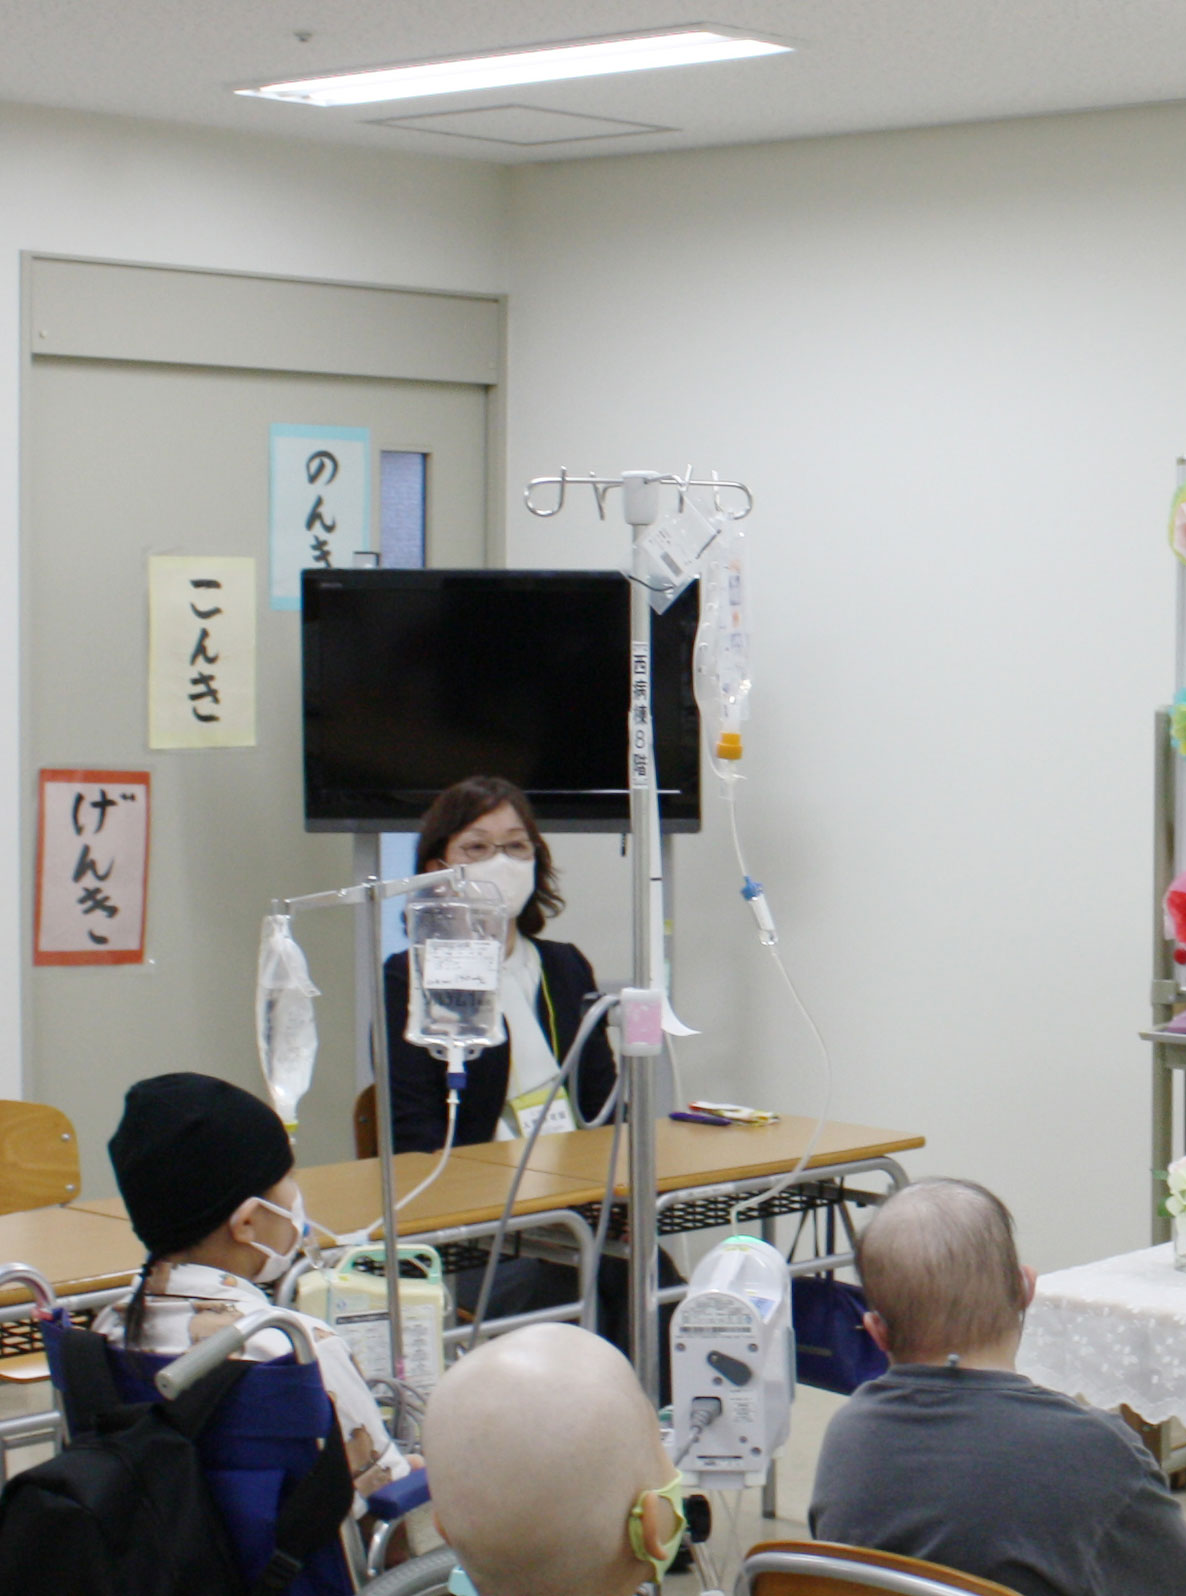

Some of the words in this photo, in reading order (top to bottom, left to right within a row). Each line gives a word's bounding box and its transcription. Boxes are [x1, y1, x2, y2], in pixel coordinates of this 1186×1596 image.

[306, 450, 339, 568] のんき
[188, 579, 223, 723] こんき
[633, 654, 648, 776] 西病棟8階
[72, 788, 137, 945] げんき
